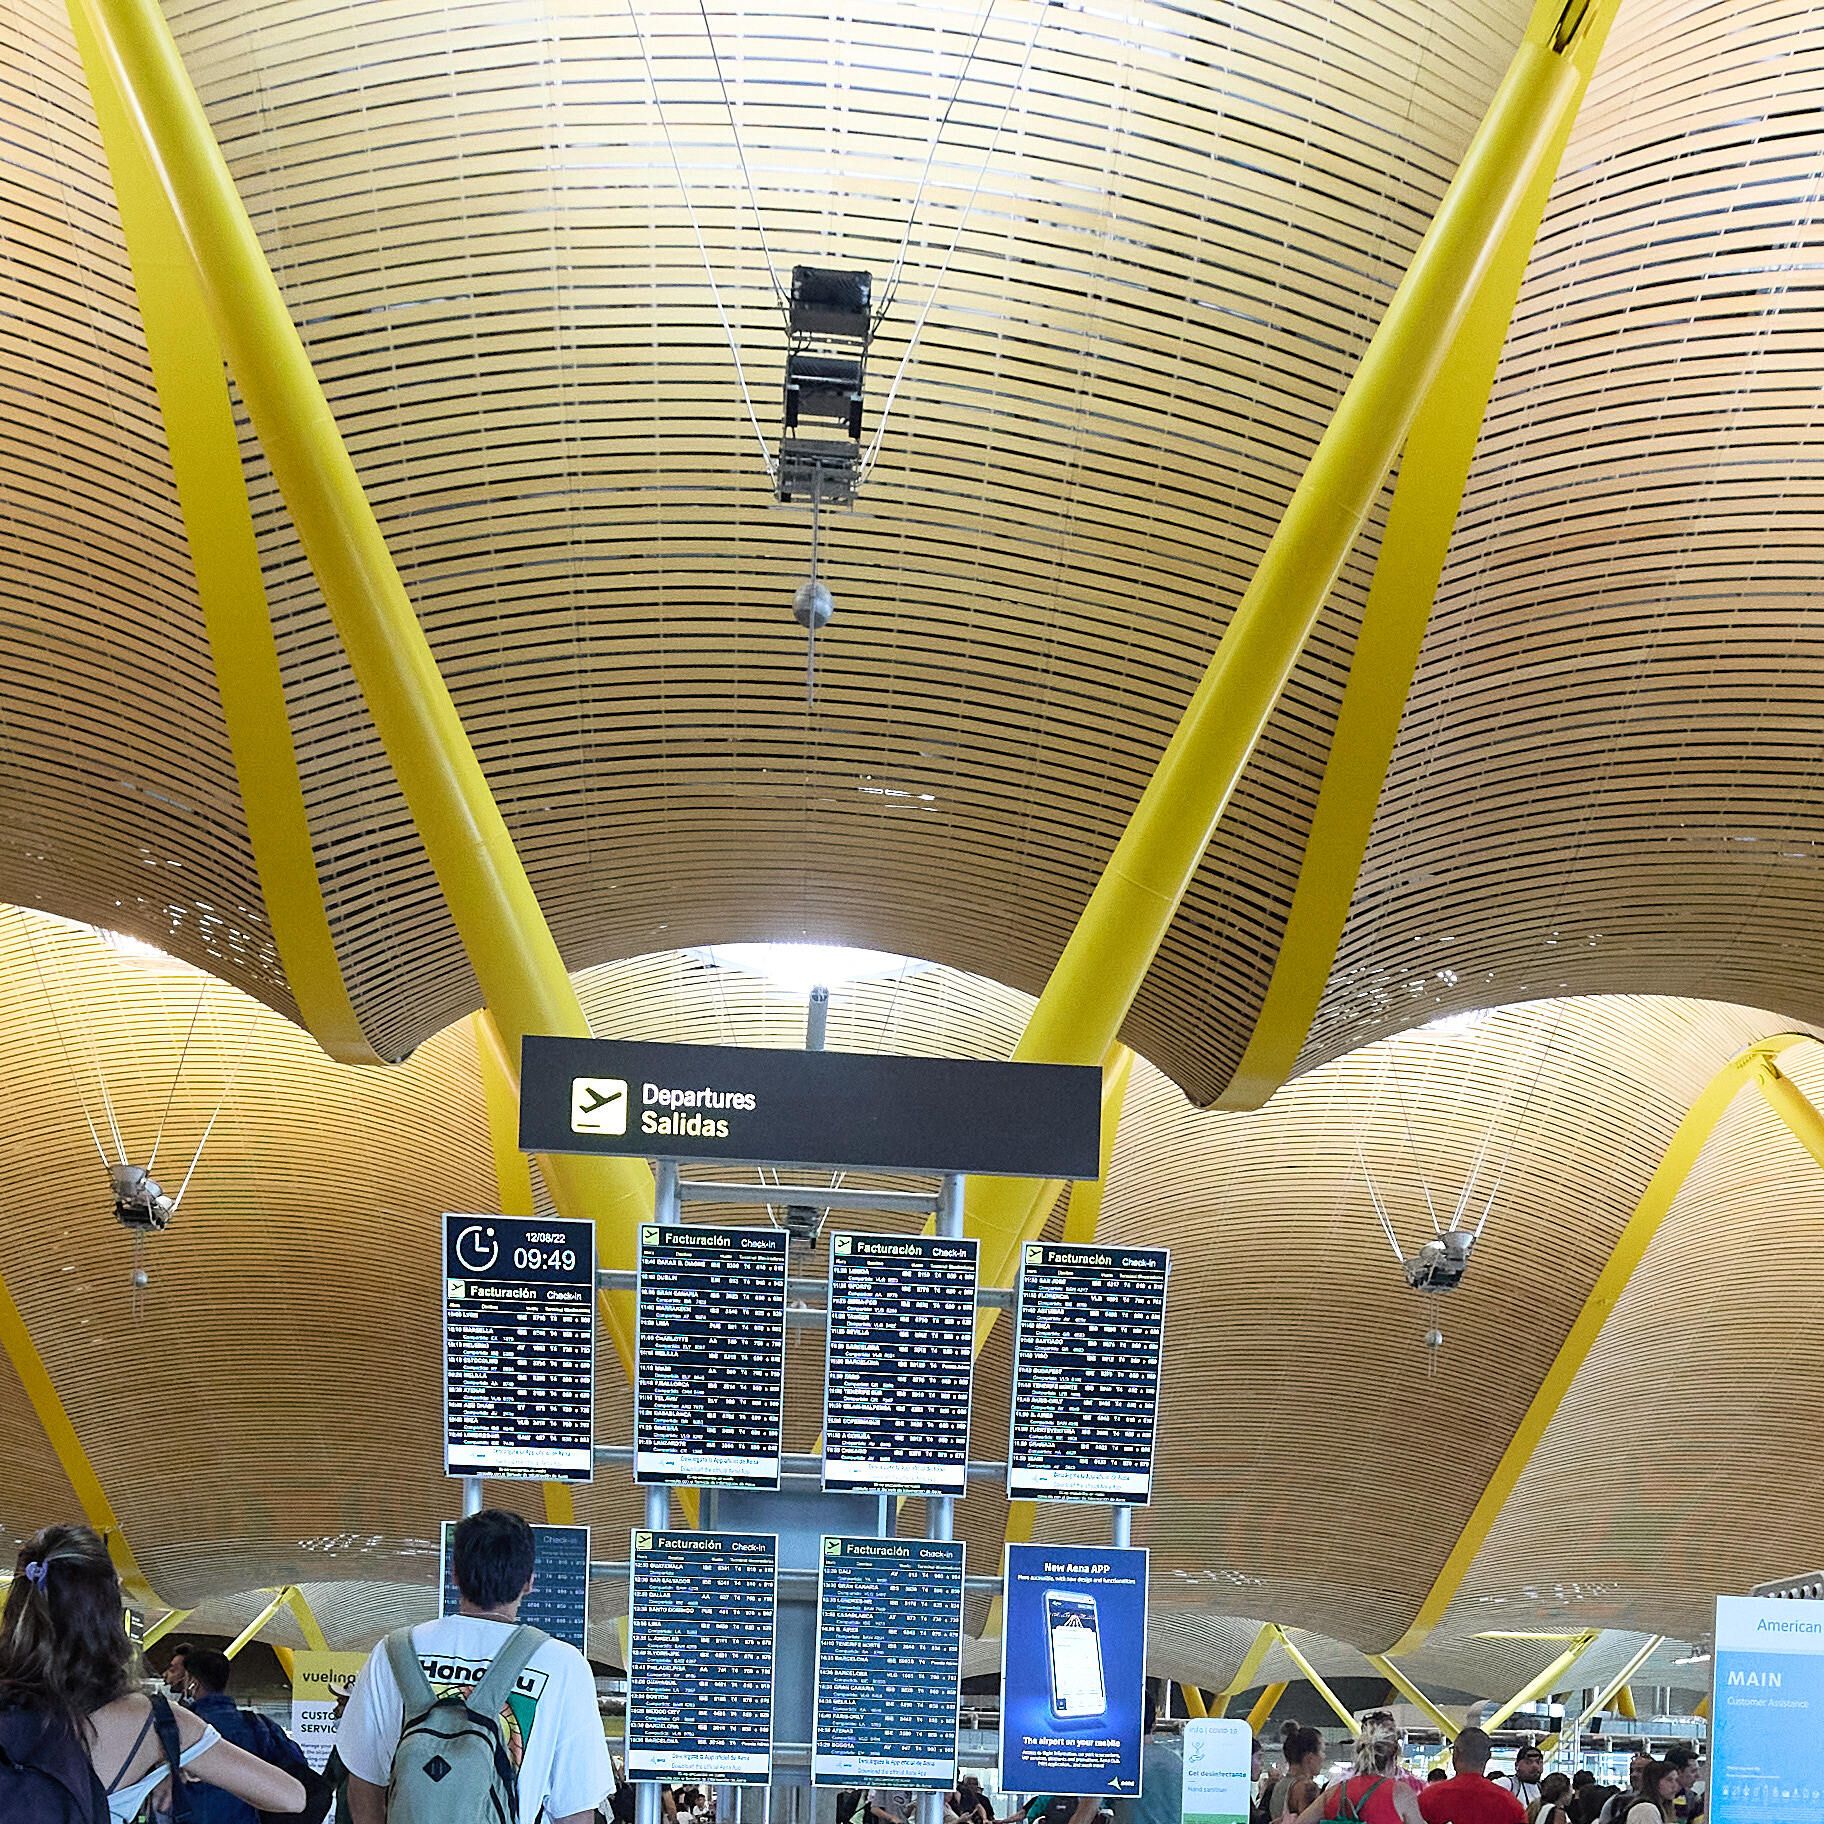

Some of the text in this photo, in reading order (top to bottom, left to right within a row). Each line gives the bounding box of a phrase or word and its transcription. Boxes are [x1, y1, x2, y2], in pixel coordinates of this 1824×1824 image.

[642, 1082, 757, 1111] Departures
[641, 1110, 730, 1138] Salidas
[526, 1232, 566, 1244] 12/08/22
[666, 1233, 730, 1247] Facturación
[858, 1242, 922, 1255] Facturación
[514, 1248, 576, 1271] 09:49
[1048, 1252, 1112, 1265] Facturación
[471, 1286, 536, 1299] Facturación
[658, 1538, 721, 1550] Facturación
[847, 1544, 909, 1556] Facturación
[1044, 1563, 1110, 1574] New Aena APP
[1757, 1618, 1822, 1634] American
[1727, 1671, 1782, 1687] MAIN
[1727, 1697, 1809, 1708] Customer Assistance
[301, 1711, 336, 1720] CUSTO
[301, 1724, 337, 1733] SERVIC
[1023, 1737, 1037, 1745] The
[1039, 1737, 1064, 1746] airport
[1095, 1739, 1120, 1747] mobile
